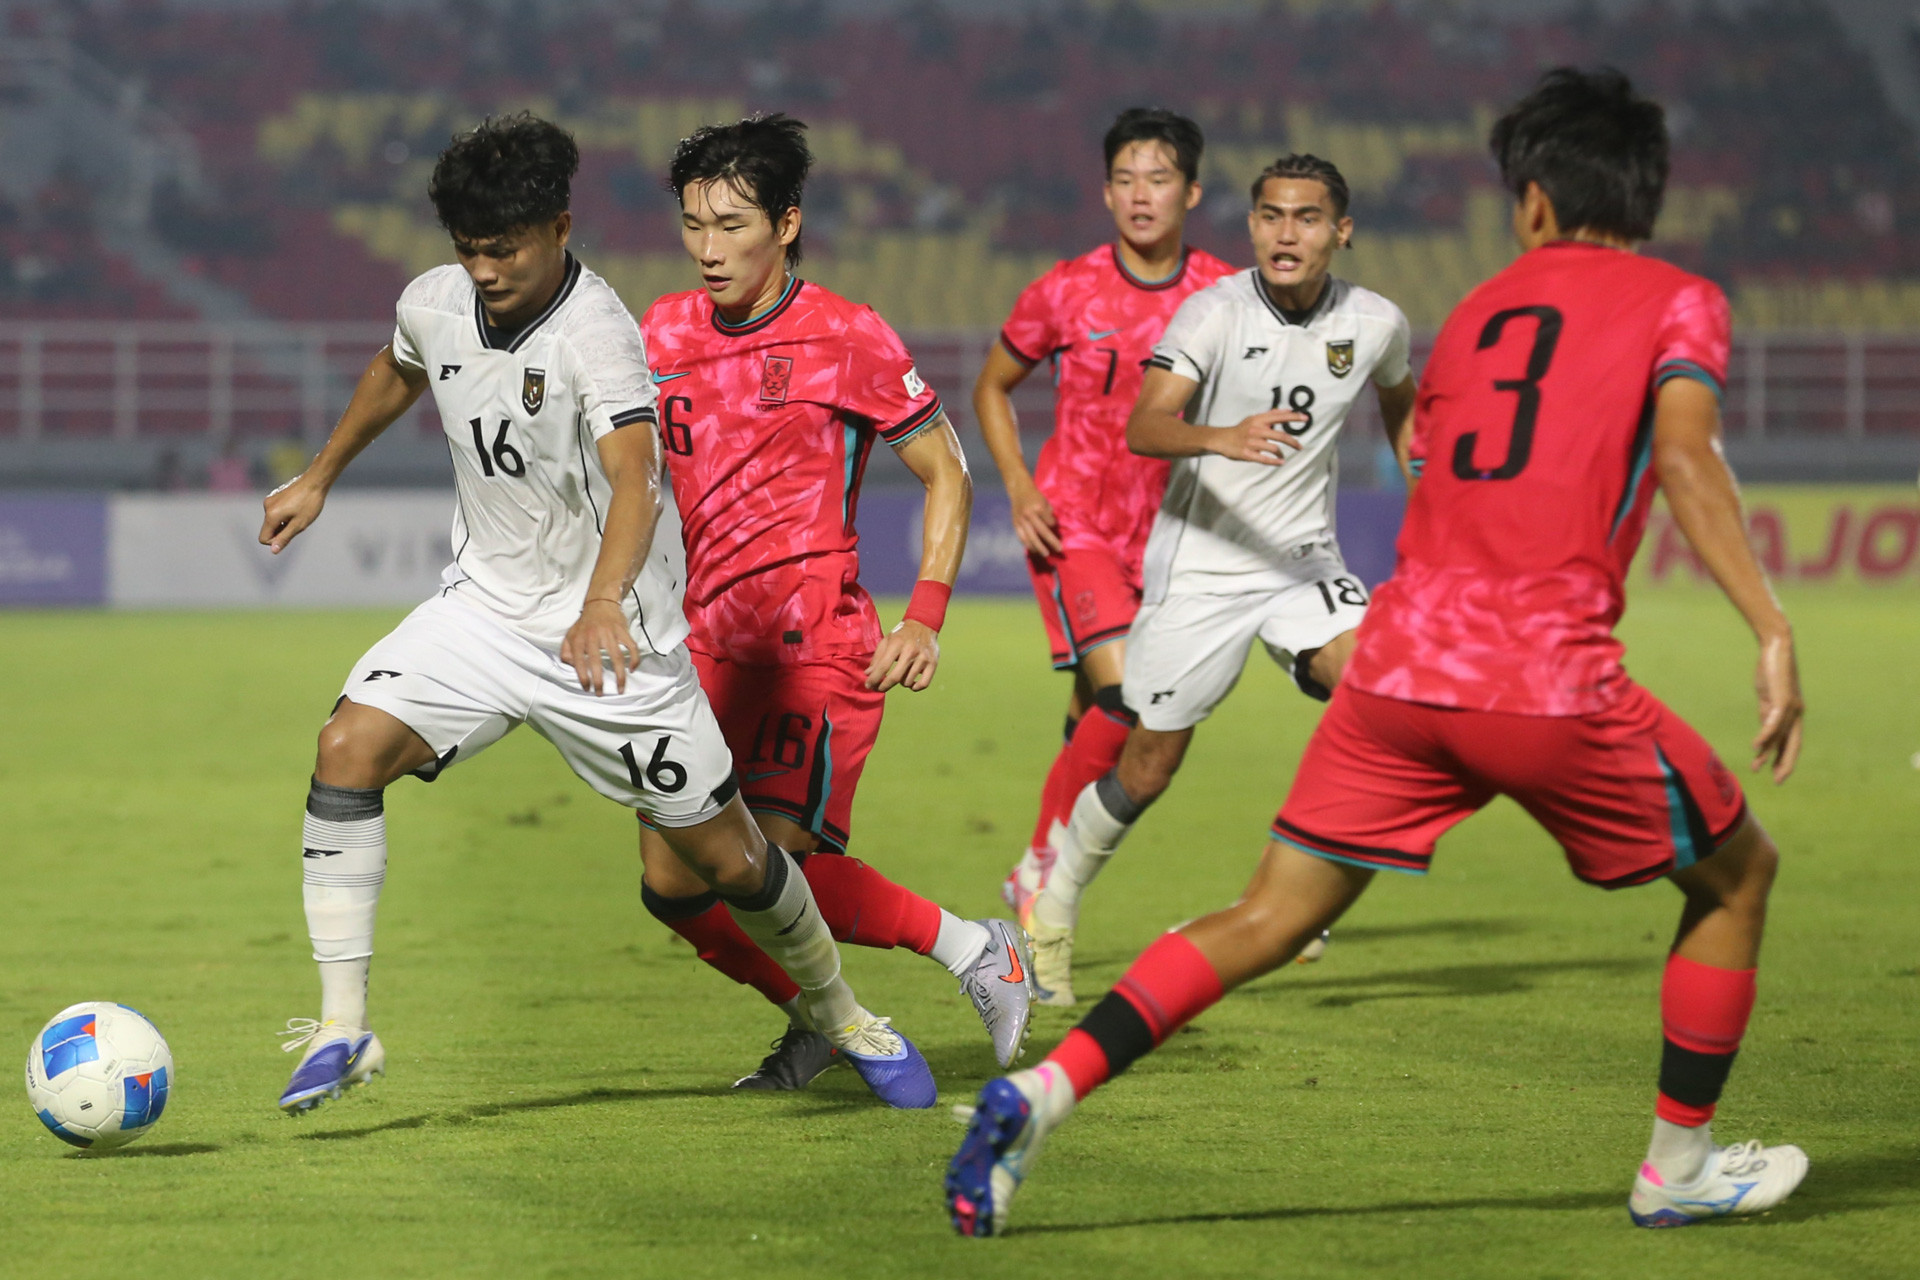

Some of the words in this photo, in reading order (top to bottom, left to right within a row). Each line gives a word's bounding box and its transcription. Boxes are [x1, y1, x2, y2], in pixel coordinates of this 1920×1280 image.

[1096, 348, 1118, 395] 7
[1452, 305, 1564, 480] 3
[663, 395, 693, 456] 6
[1271, 385, 1315, 436] 18
[468, 416, 526, 478] 16
[1315, 577, 1369, 615] 18
[617, 735, 688, 793] 16
[743, 712, 812, 770] 16
